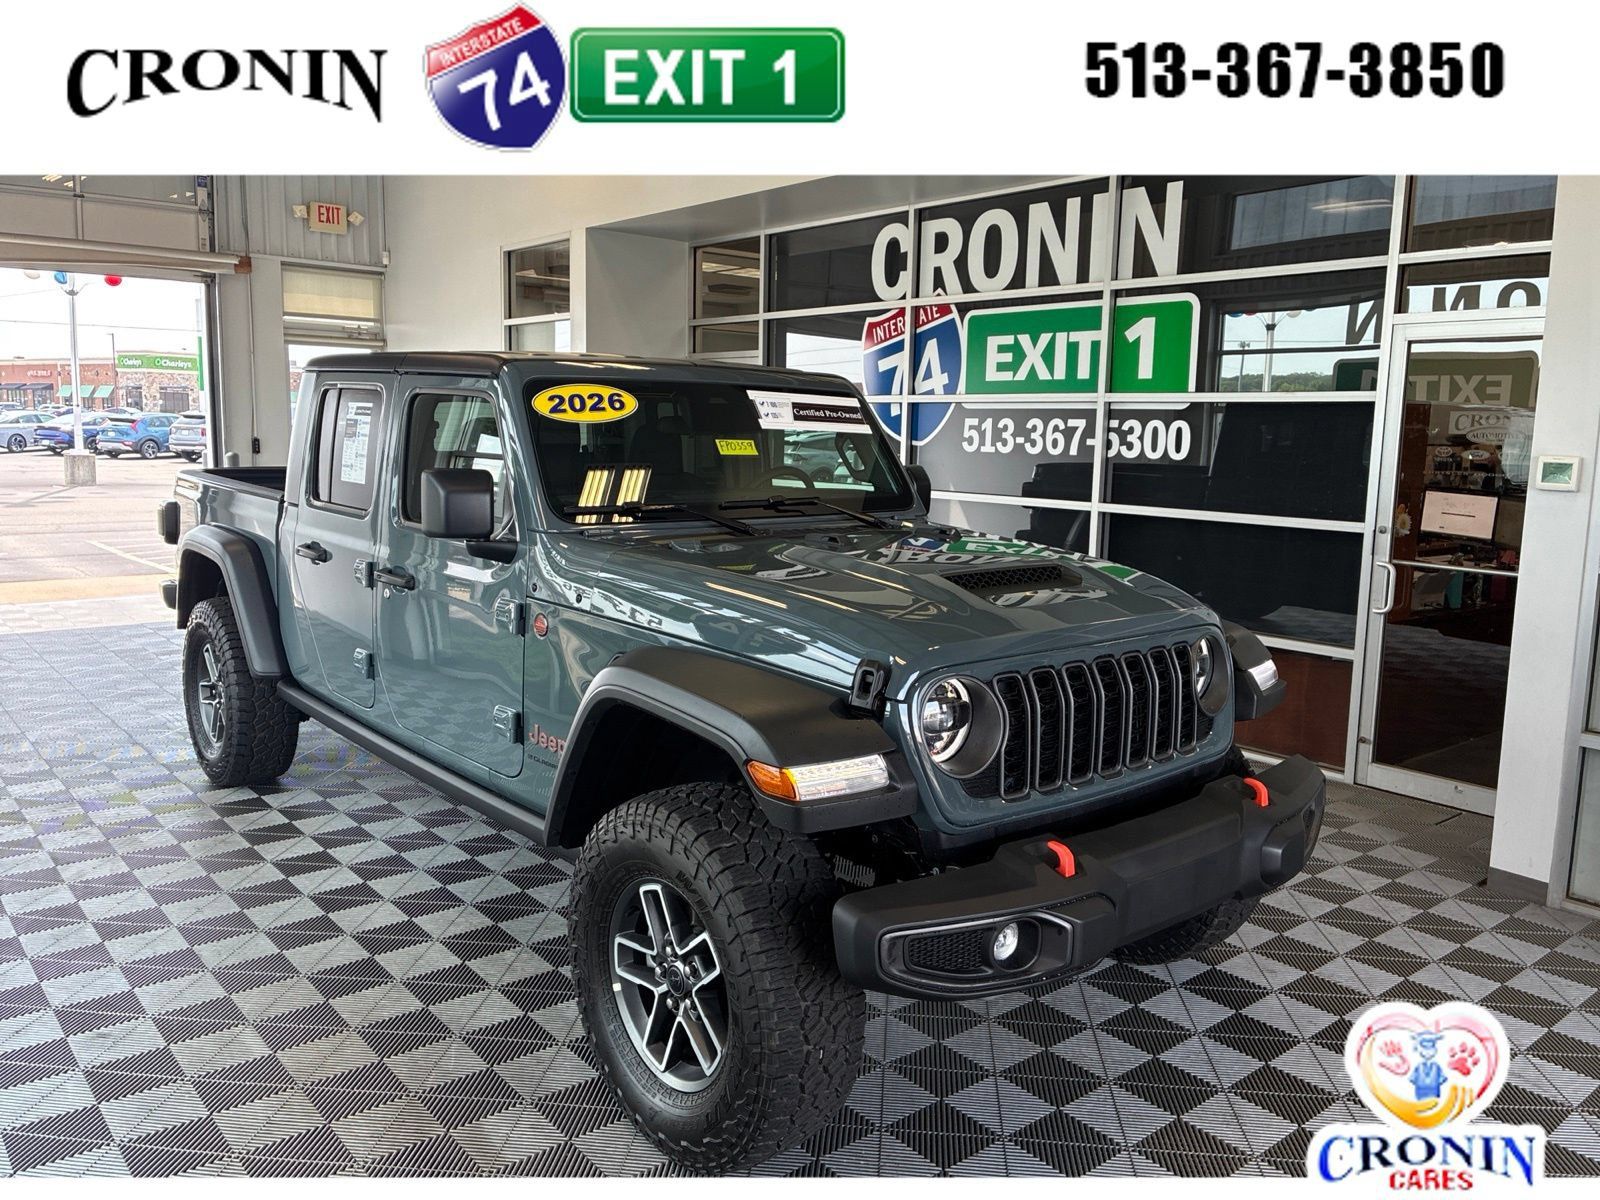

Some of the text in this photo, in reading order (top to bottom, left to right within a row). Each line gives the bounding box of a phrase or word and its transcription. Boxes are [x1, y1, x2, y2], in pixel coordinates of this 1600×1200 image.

[317, 205, 341, 225] EXIT
[871, 181, 1184, 301] CRONIN
[161, 358, 192, 369] Charleys
[985, 317, 1156, 382] EXIT 1
[878, 338, 949, 417] 74
[547, 392, 626, 414] 2026
[794, 408, 825, 418] Certified
[825, 410, 862, 420] Pre-Owned
[962, 417, 1192, 461] 513-367-5300
[528, 724, 566, 758] Jeep
